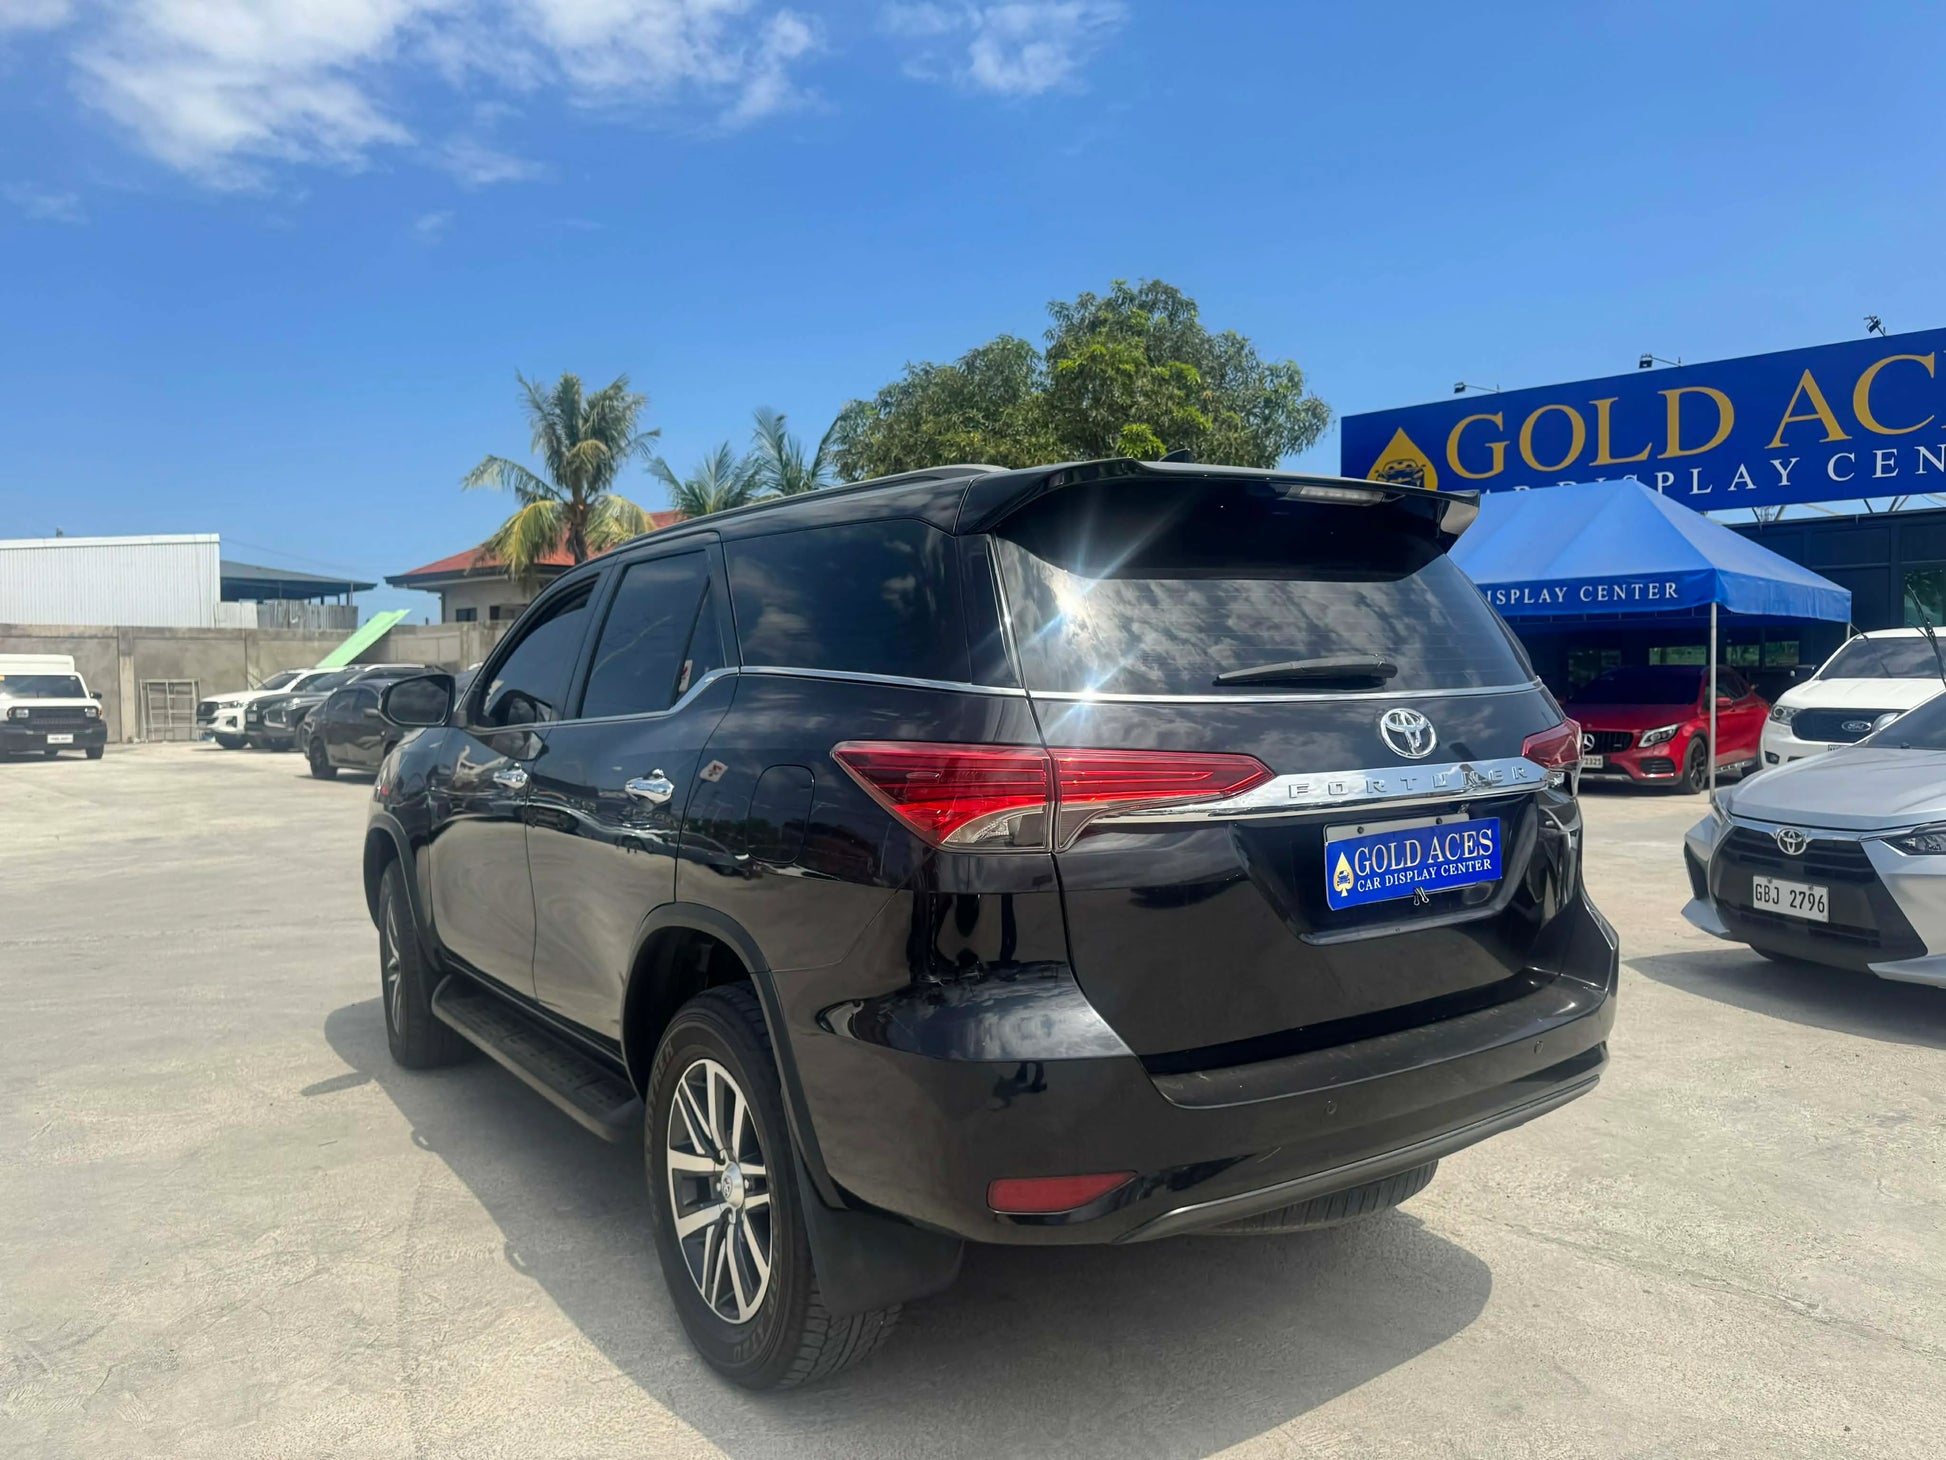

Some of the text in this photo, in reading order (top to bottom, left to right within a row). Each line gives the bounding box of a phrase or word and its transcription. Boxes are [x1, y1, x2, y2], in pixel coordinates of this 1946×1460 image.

[1445, 350, 1946, 480] GOLD AC
[1579, 582, 1679, 602] CENTER
[1288, 766, 1528, 799] FORTUNER
[1354, 828, 1494, 876] GOLD ACES
[1357, 858, 1492, 892] CAR DISPLAY CENTER
[1755, 883, 1825, 913] GBJ 2796
